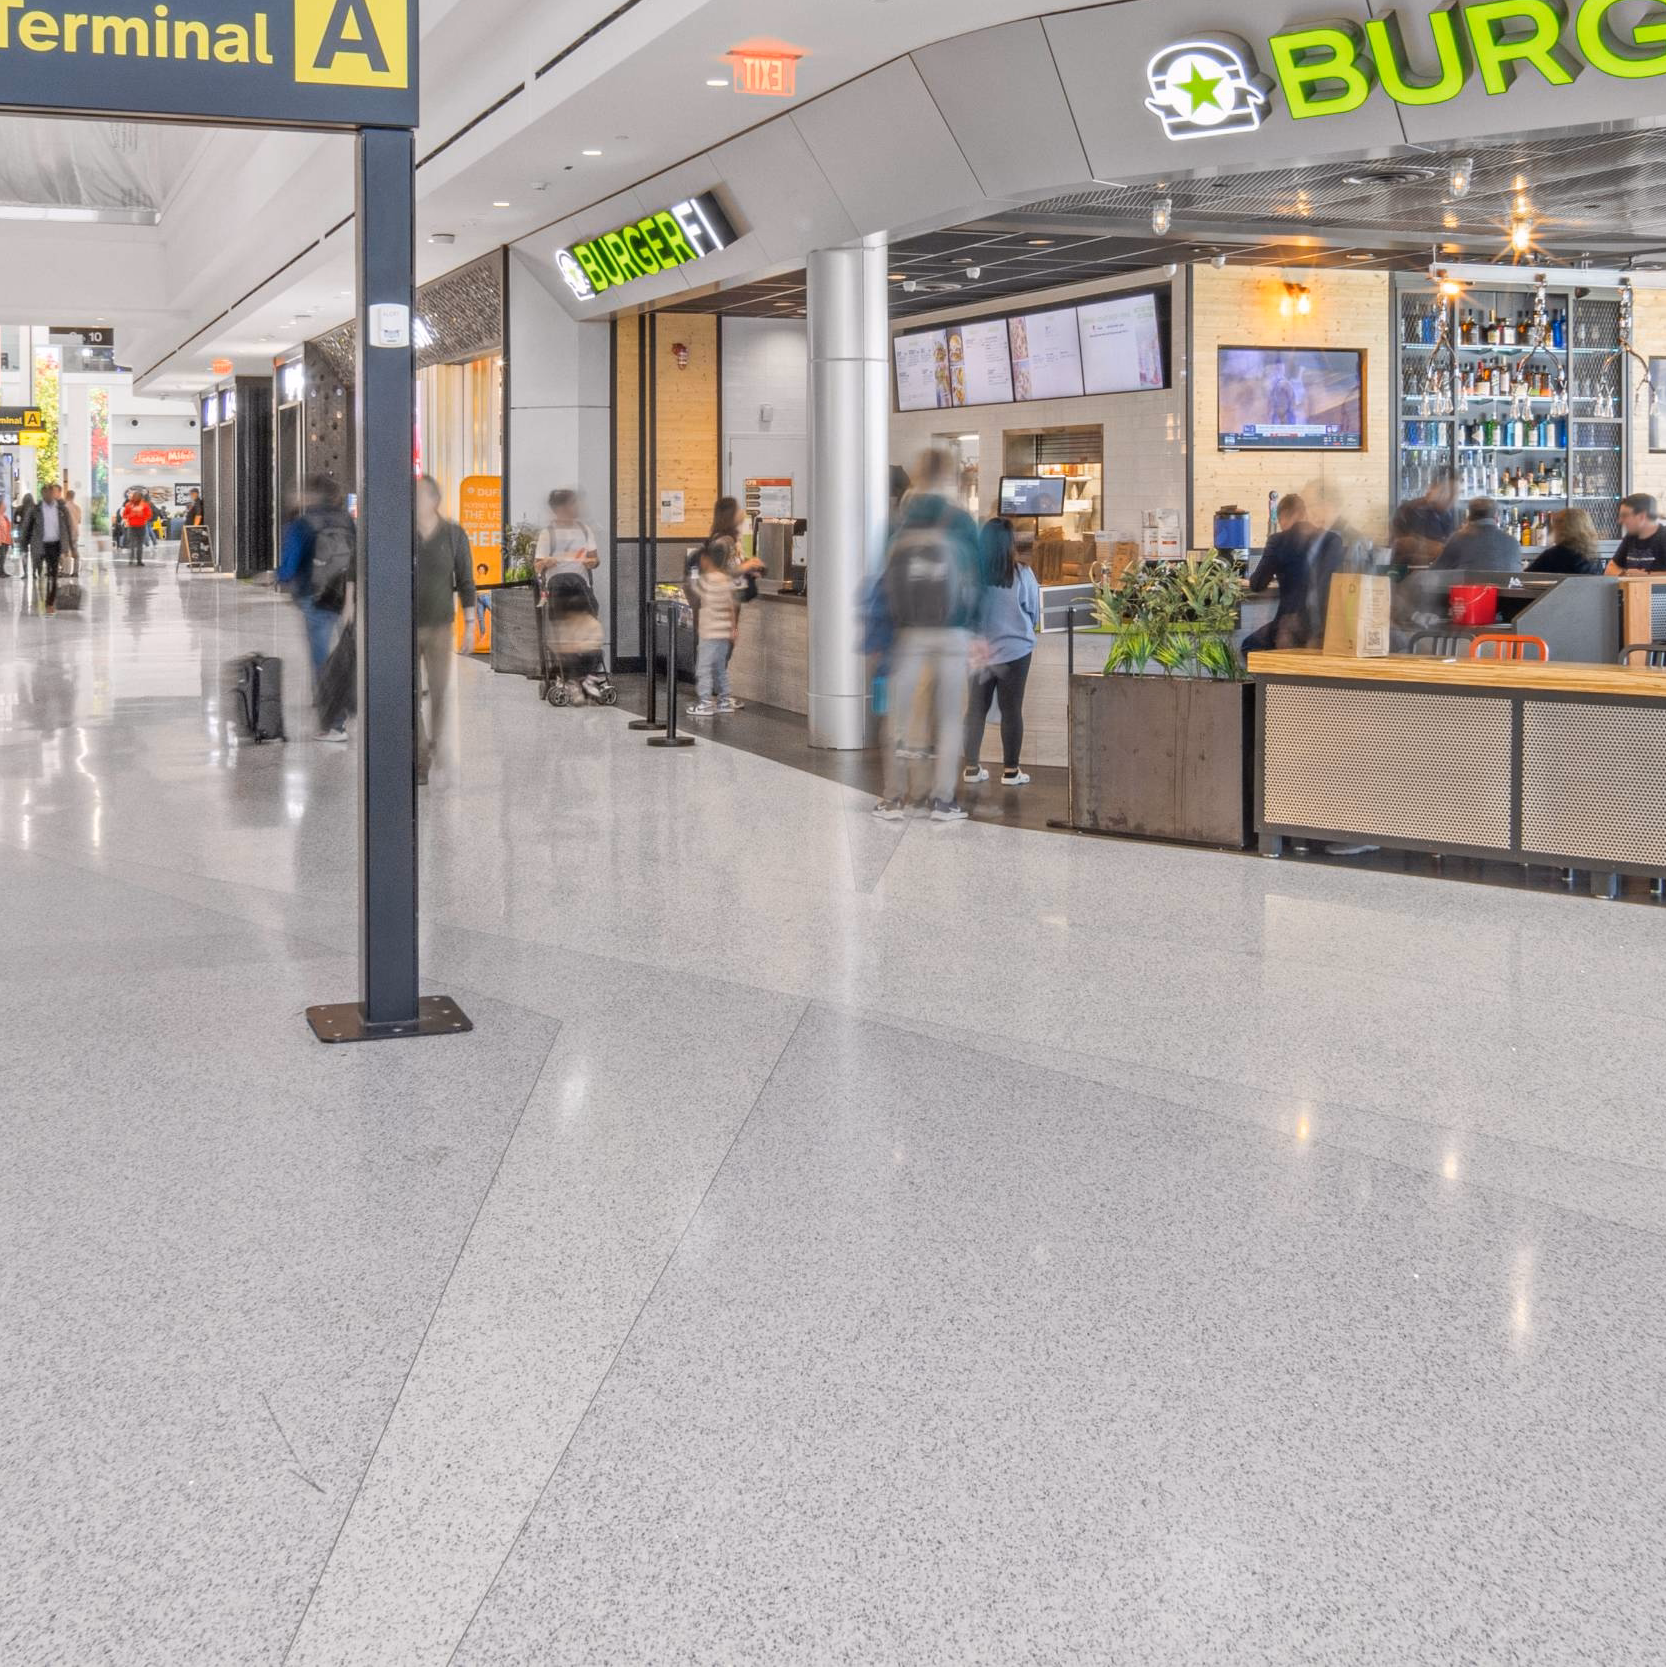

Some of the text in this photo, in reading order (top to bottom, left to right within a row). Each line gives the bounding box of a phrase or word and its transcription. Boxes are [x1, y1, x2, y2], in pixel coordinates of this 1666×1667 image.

[573, 197, 724, 292] BURGERFI
[88, 331, 103, 342] 10
[27, 413, 38, 425] A
